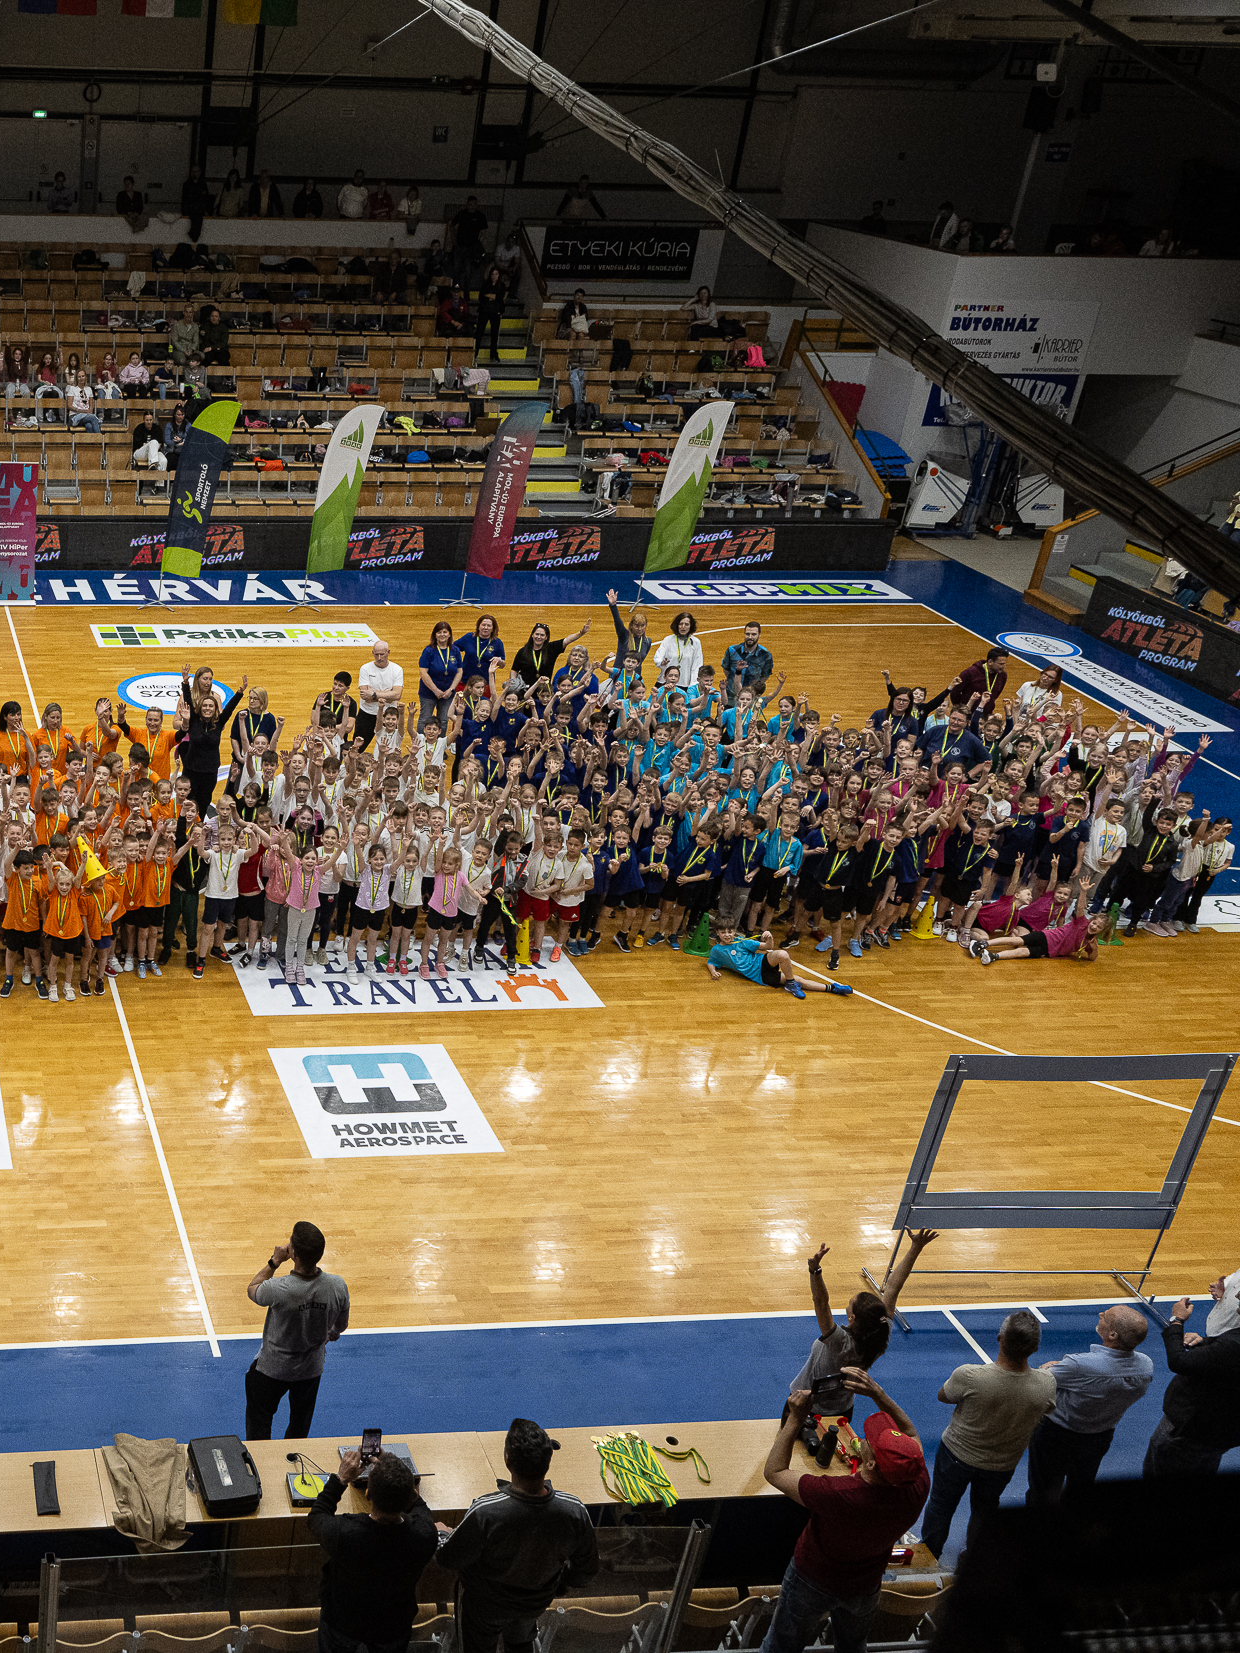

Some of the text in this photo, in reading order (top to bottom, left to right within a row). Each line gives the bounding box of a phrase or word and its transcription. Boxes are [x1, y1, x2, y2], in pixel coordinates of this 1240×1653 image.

[435, 127, 447, 137] WC
[549, 237, 691, 257] ETYEKI KÚRIA
[953, 304, 1005, 312] PARTNER
[949, 313, 1040, 332] BÚTORHÁZ
[194, 463, 209, 502] SPORTOLÓ
[501, 472, 514, 506] MOL-ÚJ
[200, 480, 212, 510] NEMZET
[487, 470, 505, 524] ALAPÍTVÁNY
[492, 505, 507, 538] EURÓPA
[360, 551, 424, 569] PROGRAM
[536, 551, 600, 570] PROGRAM
[709, 551, 773, 570] PROGRAM
[1107, 606, 1167, 628] KÖLYÖKBŐL
[161, 627, 370, 640] PatikaPlus
[1137, 649, 1198, 672] PROGRAM
[1160, 704, 1210, 728] SZABÓ
[268, 977, 499, 1007] TRAVEL
[331, 1120, 458, 1137] HOWMET
[339, 1134, 468, 1148] AEROSPACE
